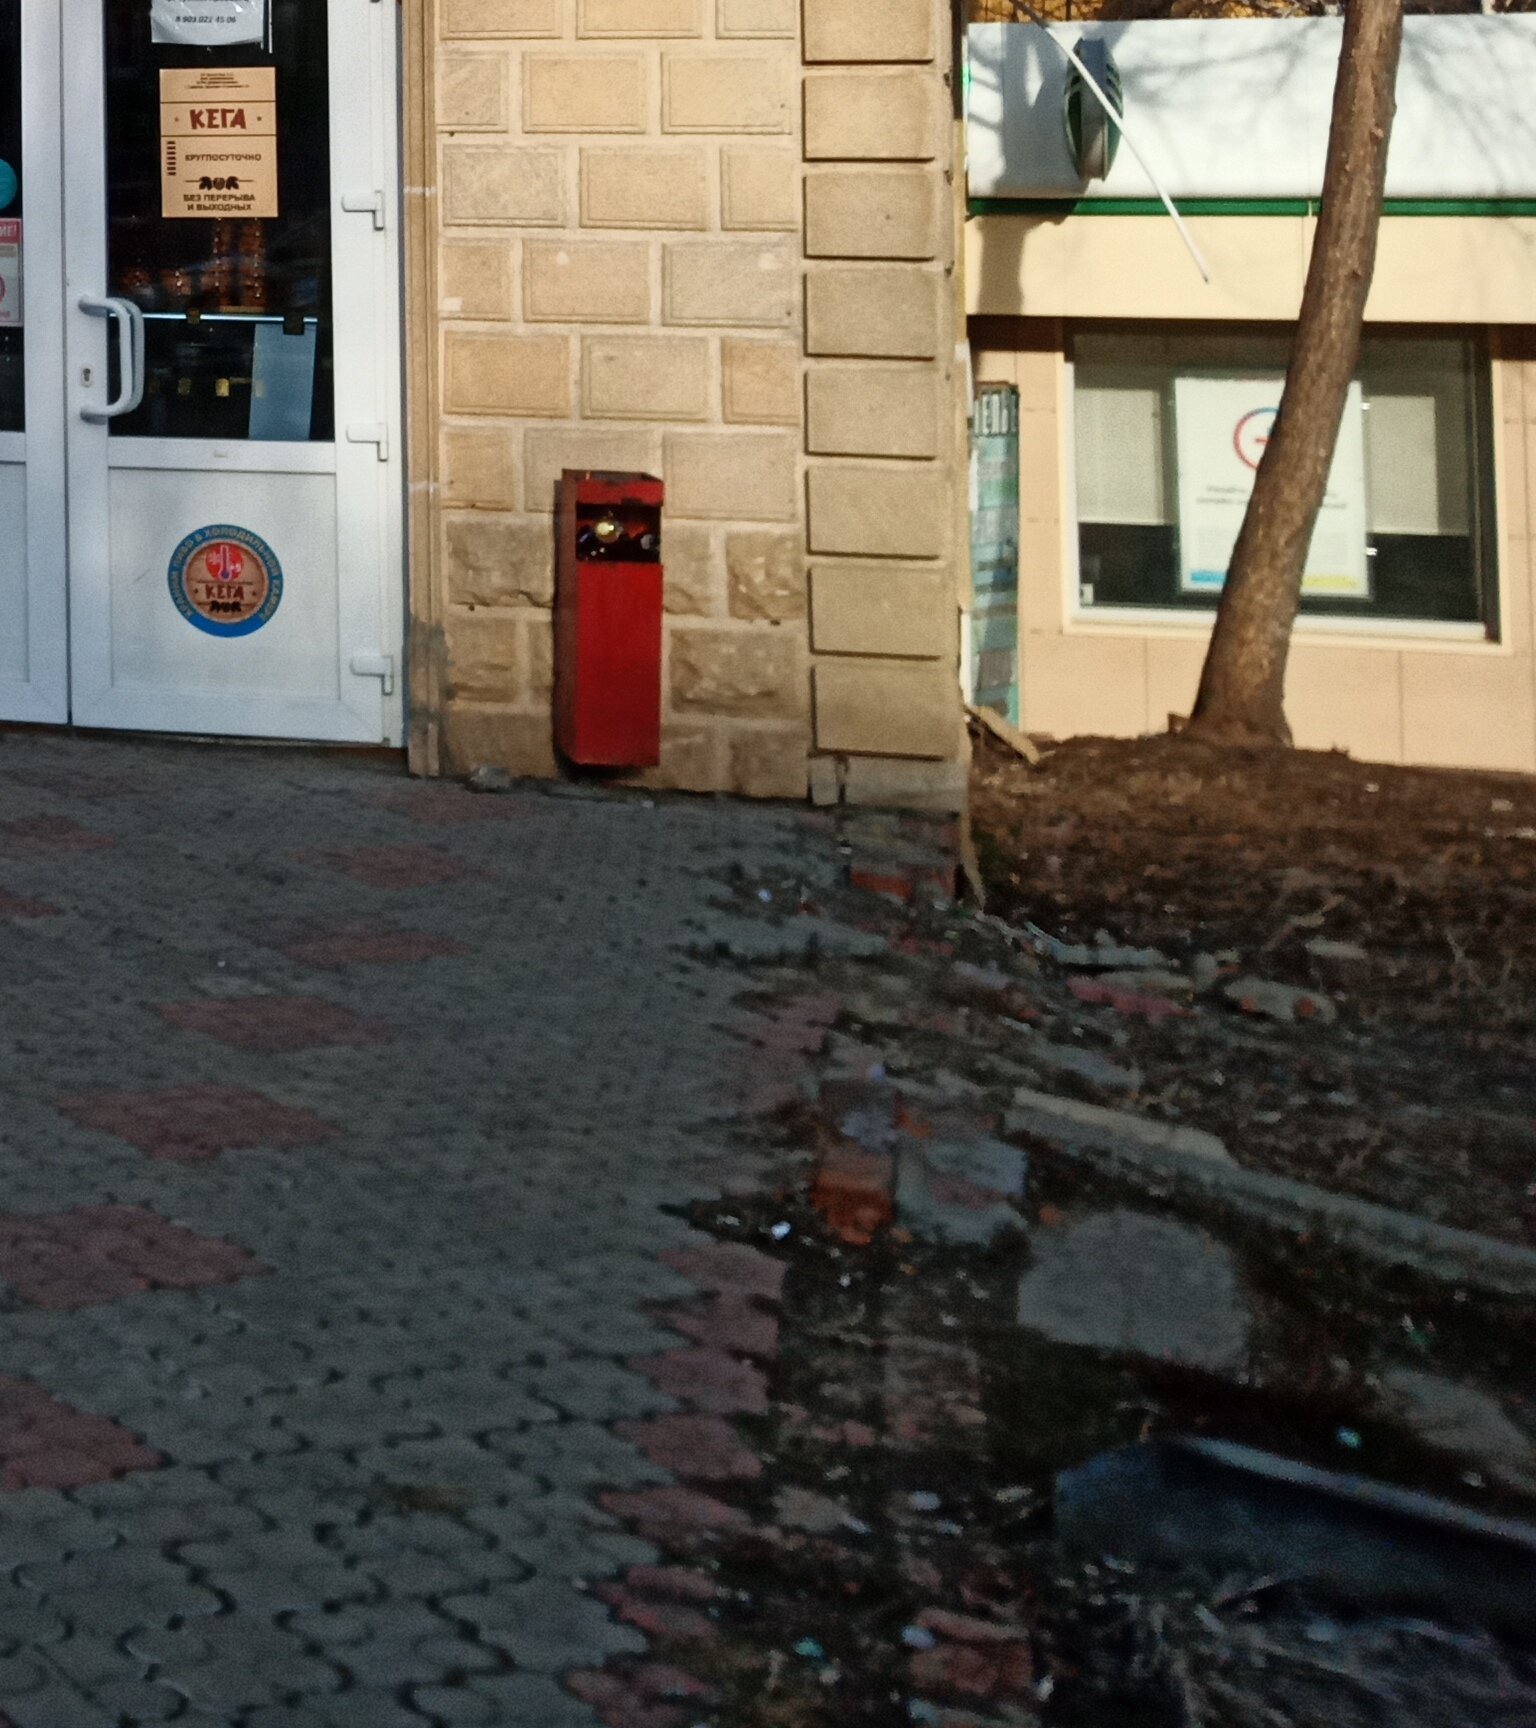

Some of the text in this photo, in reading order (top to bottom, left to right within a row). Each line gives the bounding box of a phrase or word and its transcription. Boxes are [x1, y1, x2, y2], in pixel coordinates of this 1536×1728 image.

[189, 108, 246, 130] КЕГА
[185, 153, 262, 162] КРУГЛОСУТОЧНО
[205, 584, 245, 600] КЕГА
